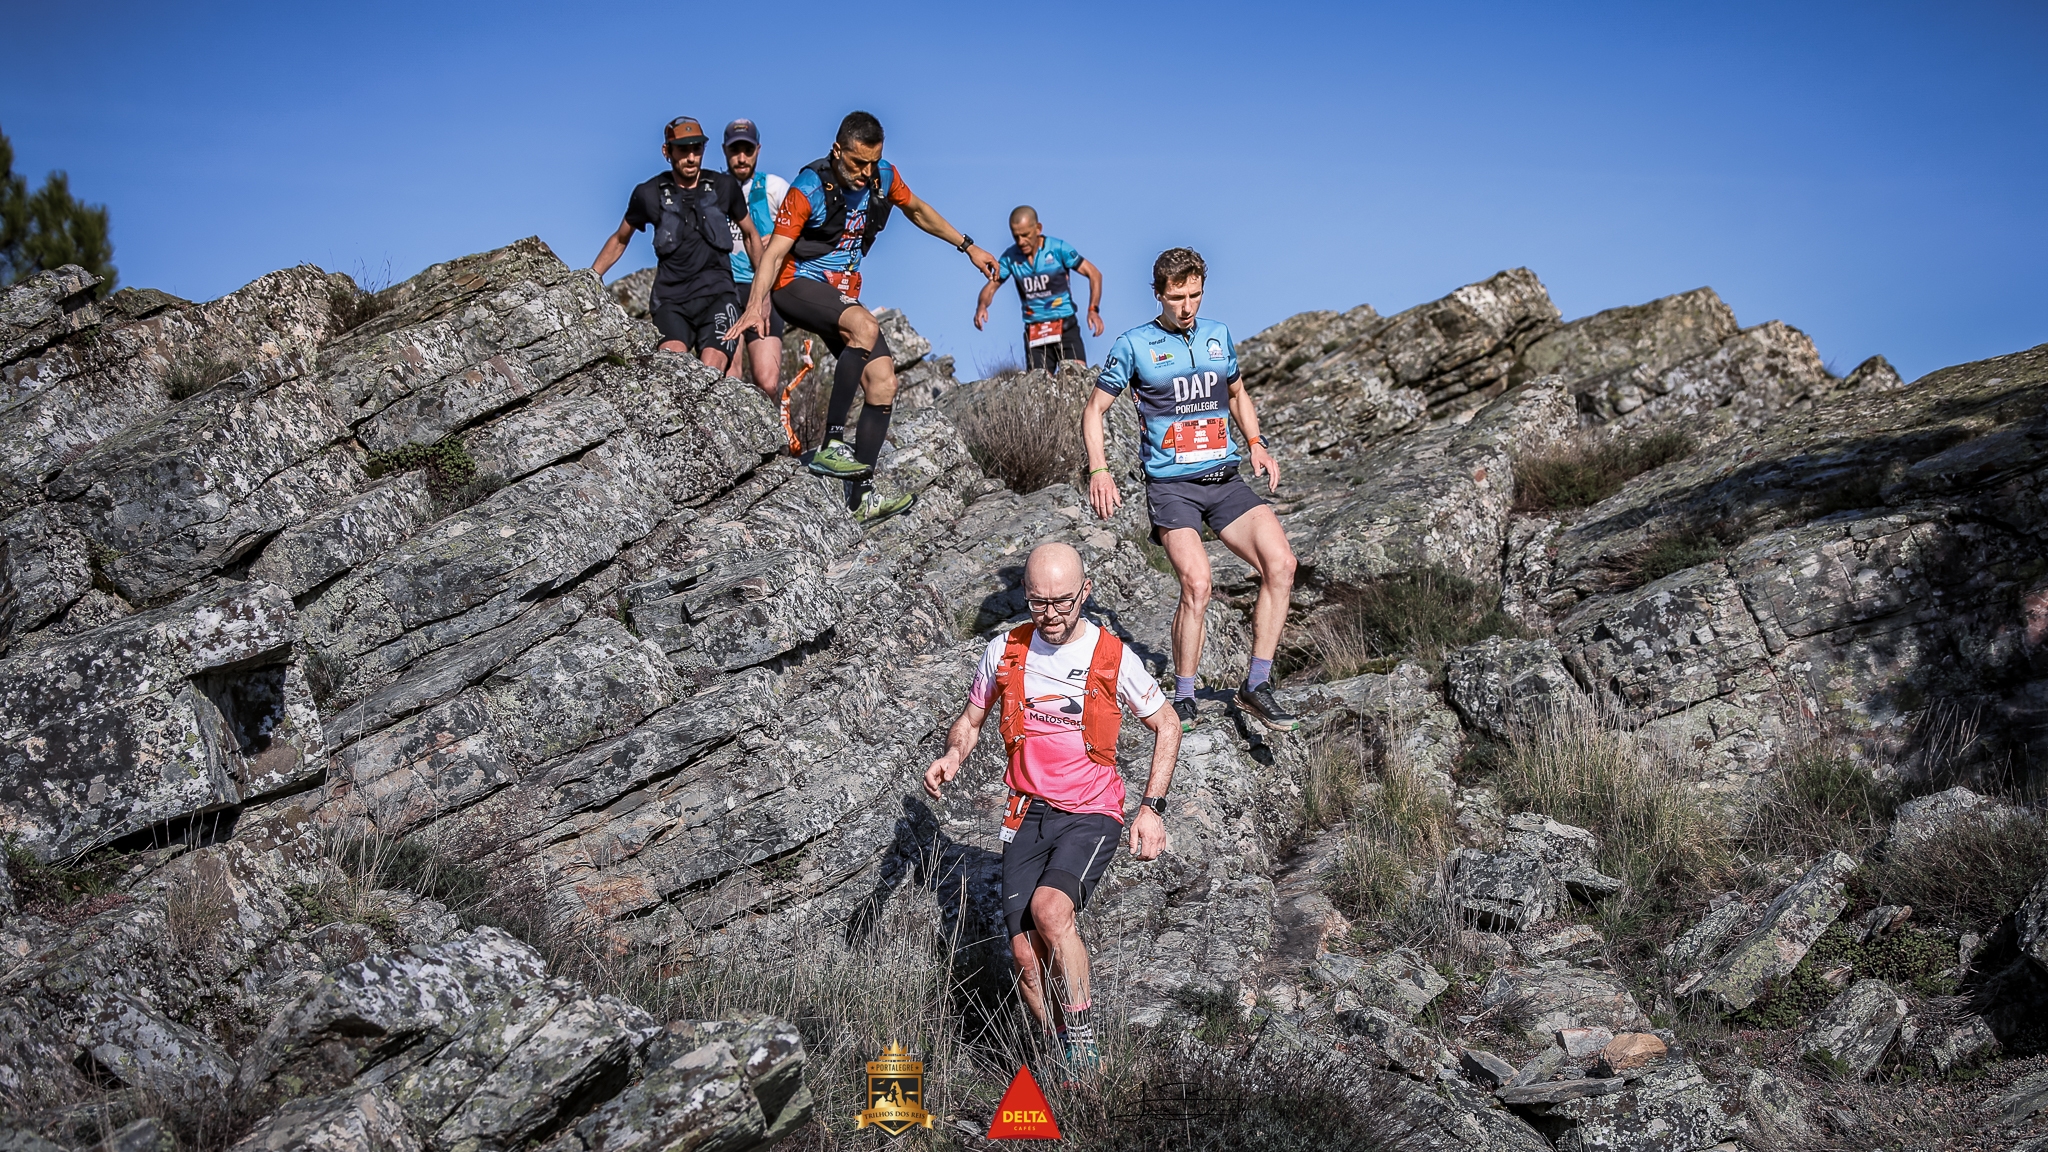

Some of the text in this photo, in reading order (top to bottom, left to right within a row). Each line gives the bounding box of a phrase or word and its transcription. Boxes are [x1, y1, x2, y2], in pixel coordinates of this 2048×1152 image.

[1023, 274, 1050, 292] DAP
[1172, 371, 1218, 402] DAP
[1175, 400, 1219, 415] PORTALEGRE
